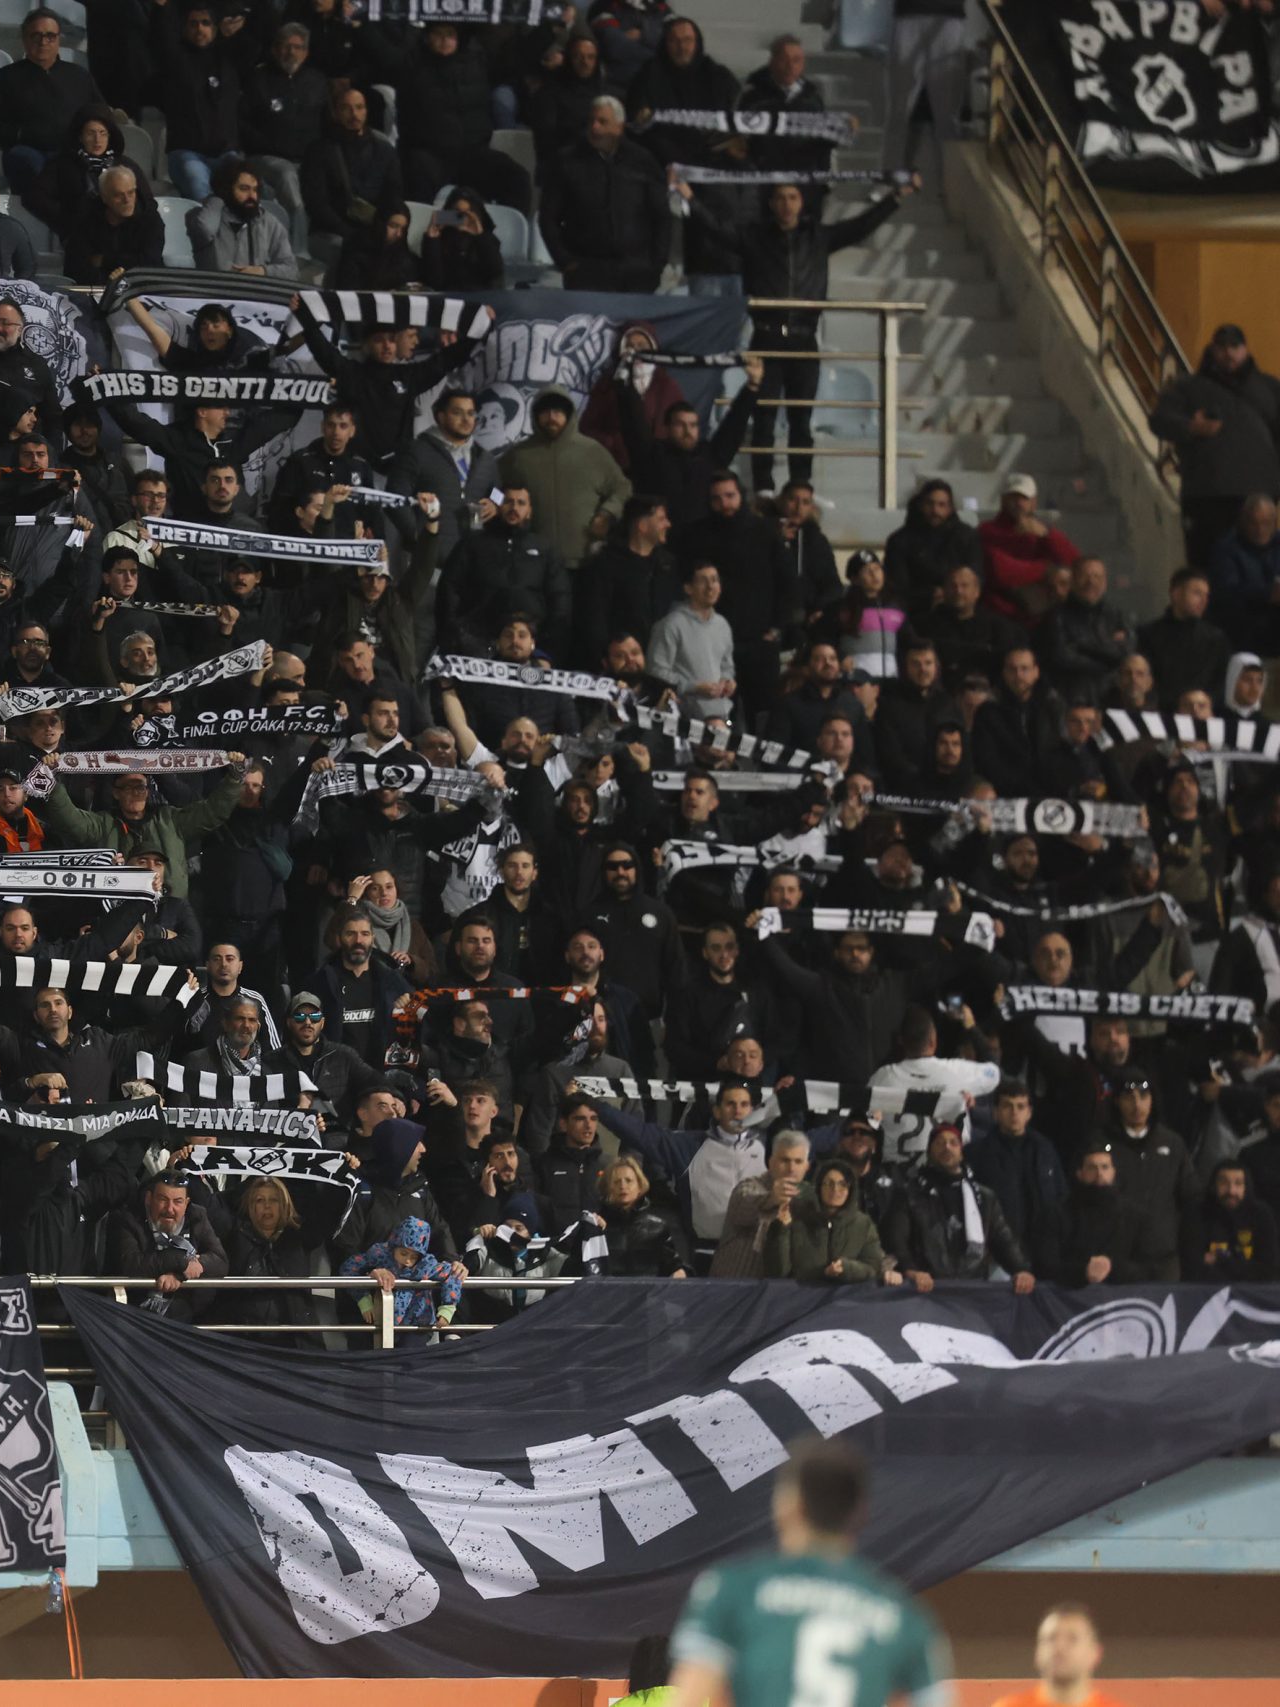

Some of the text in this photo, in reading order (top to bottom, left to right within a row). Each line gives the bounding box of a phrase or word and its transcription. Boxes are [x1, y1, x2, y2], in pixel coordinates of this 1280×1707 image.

[84, 373, 147, 401] THIS
[152, 375, 178, 398] IS
[185, 377, 266, 401] GENTI
[147, 522, 367, 559] CRETAN CULTURE
[198, 705, 326, 724] ΟΦΗ F.C.
[183, 722, 217, 738] FINAL
[221, 719, 247, 735] CUP
[250, 718, 285, 733] OAKA
[158, 753, 226, 768] CRETA
[1008, 986, 1256, 1025] HERE IS CRETE
[19, 1112, 74, 1132] ΝΗΣΙ
[82, 1116, 112, 1131] ΜΙΑ
[177, 1107, 317, 1140] FANATICS
